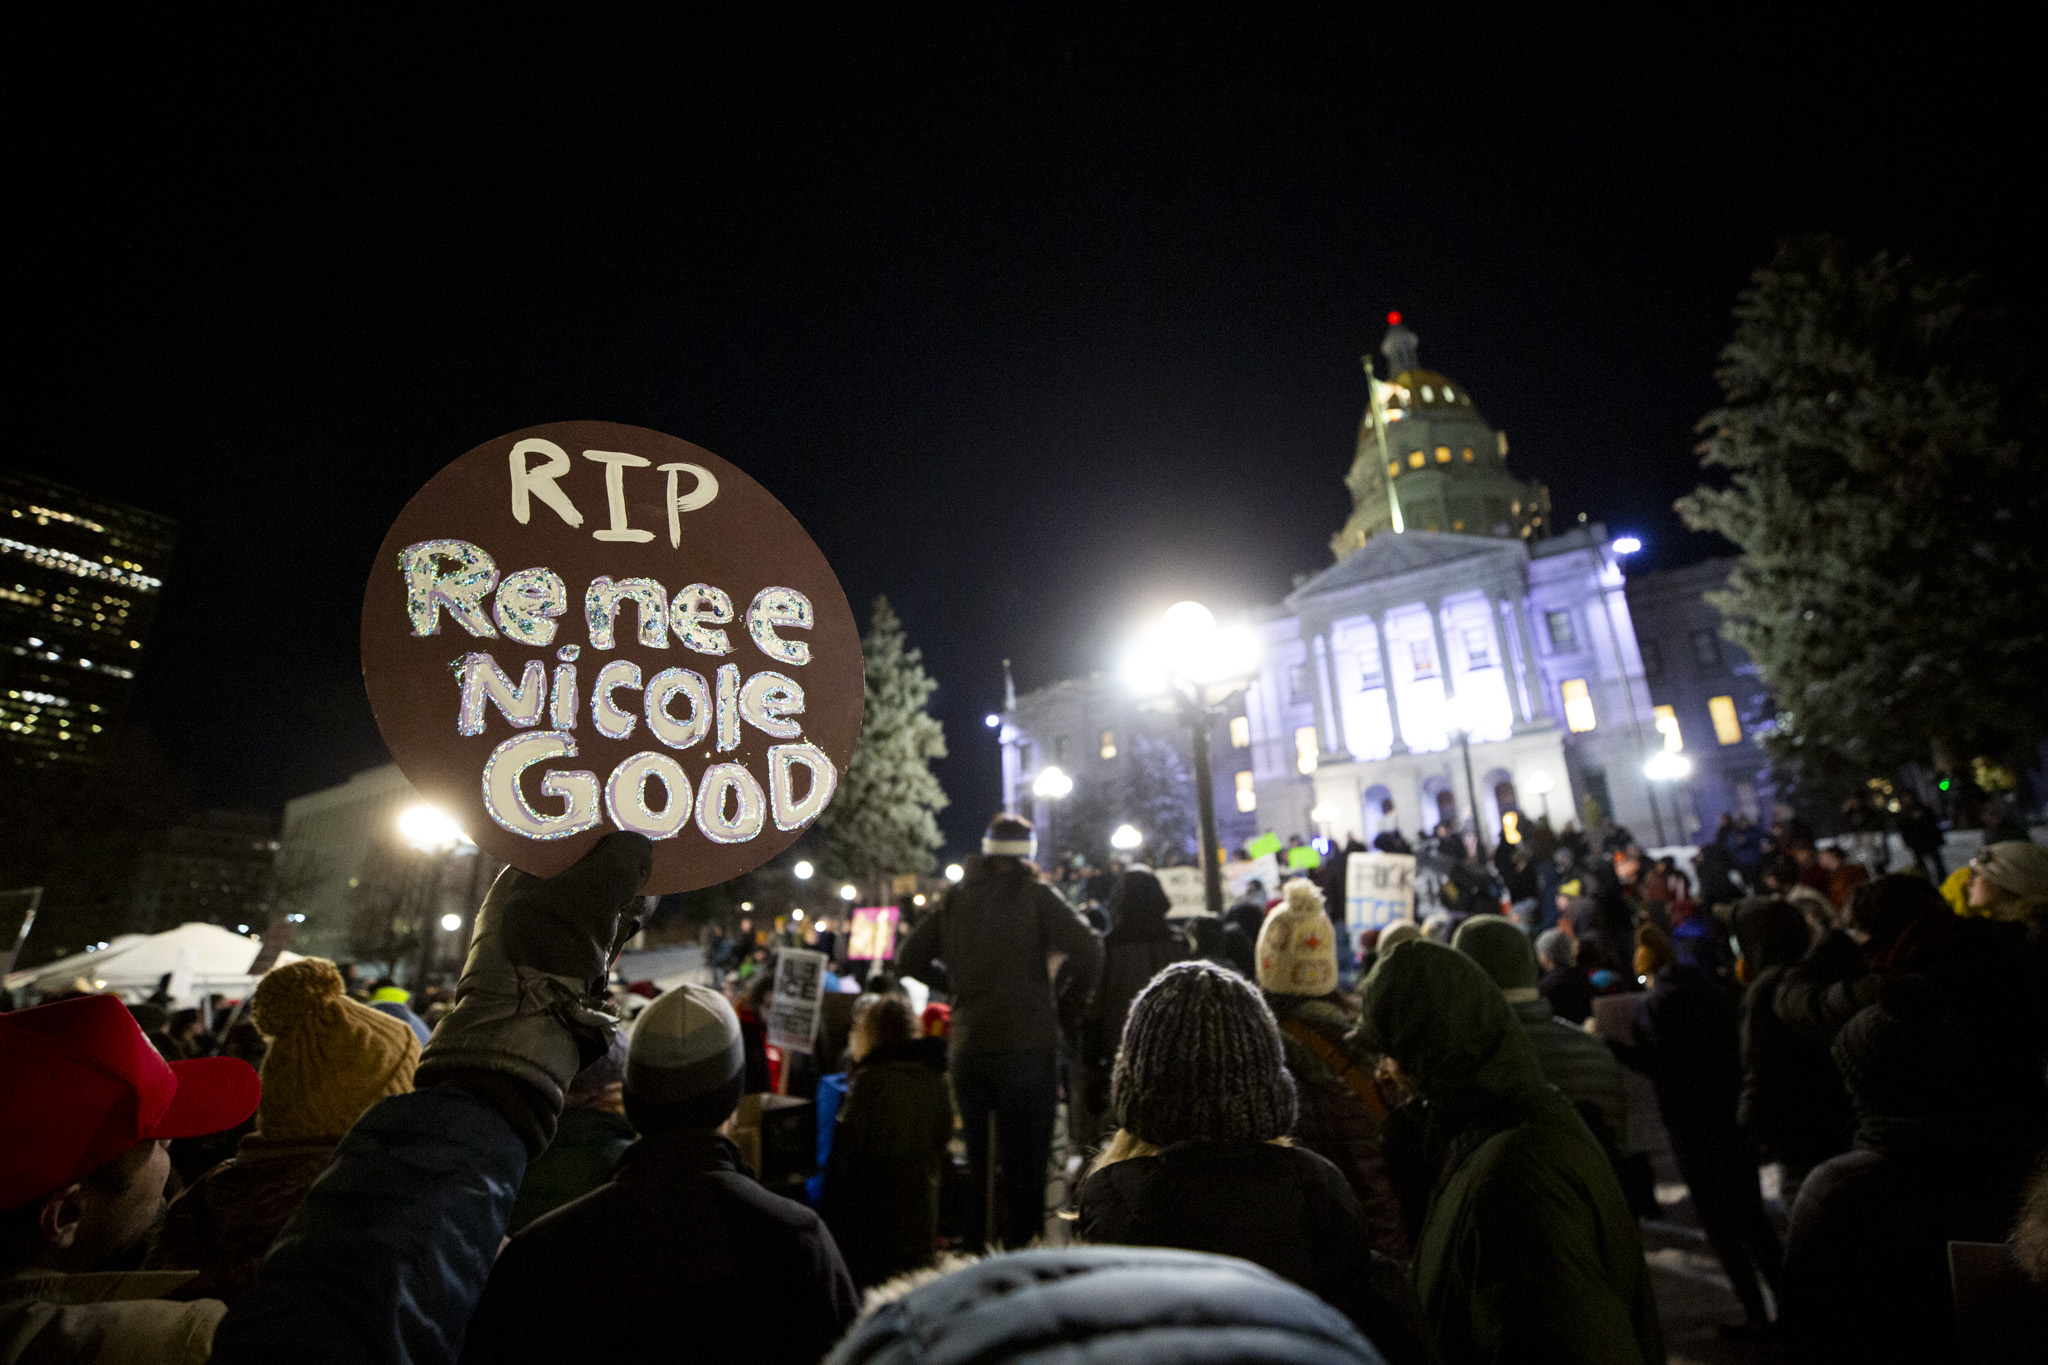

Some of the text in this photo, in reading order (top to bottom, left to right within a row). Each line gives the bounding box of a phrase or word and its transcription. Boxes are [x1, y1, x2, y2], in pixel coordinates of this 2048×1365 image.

[508, 438, 719, 549] RIP
[399, 539, 815, 666] Renee
[450, 645, 806, 752] Nicole
[482, 730, 838, 844] GOOD
